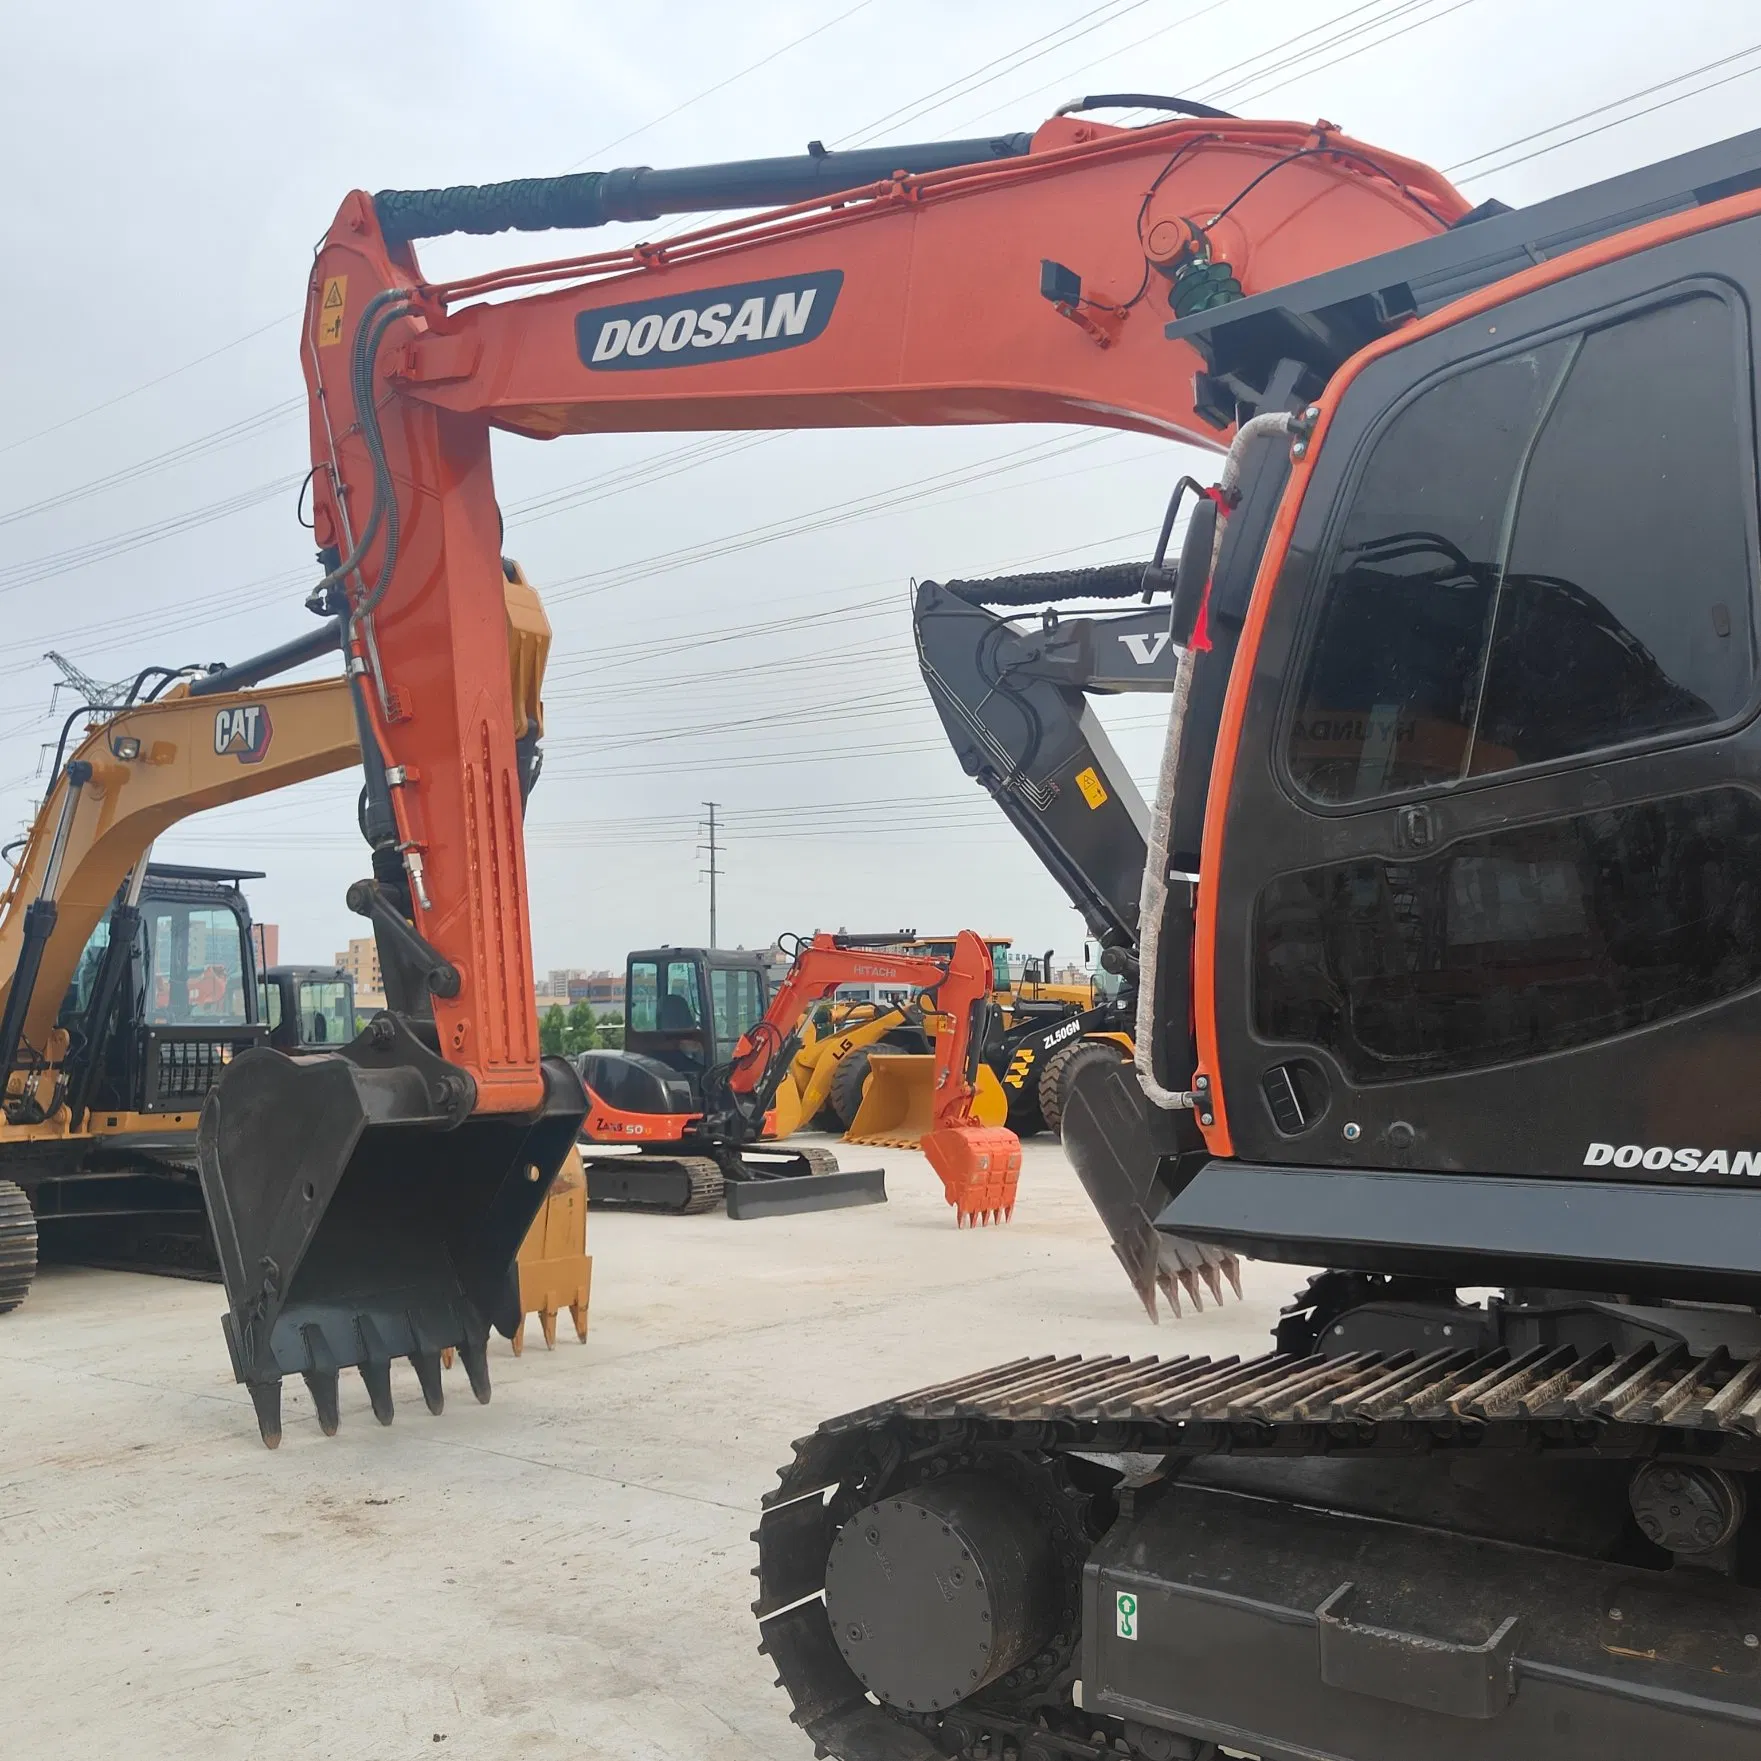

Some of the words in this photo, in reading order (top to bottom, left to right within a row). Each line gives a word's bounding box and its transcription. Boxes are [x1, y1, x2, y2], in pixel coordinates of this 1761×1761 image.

[591, 288, 818, 363] DOOSAN
[1118, 631, 1178, 664] V
[215, 707, 260, 753] CAT
[853, 964, 897, 977] HITACHI
[832, 1038, 854, 1061] LG
[1042, 1019, 1081, 1050] ZL50GN
[1583, 1143, 1761, 1177] DOOSAN
